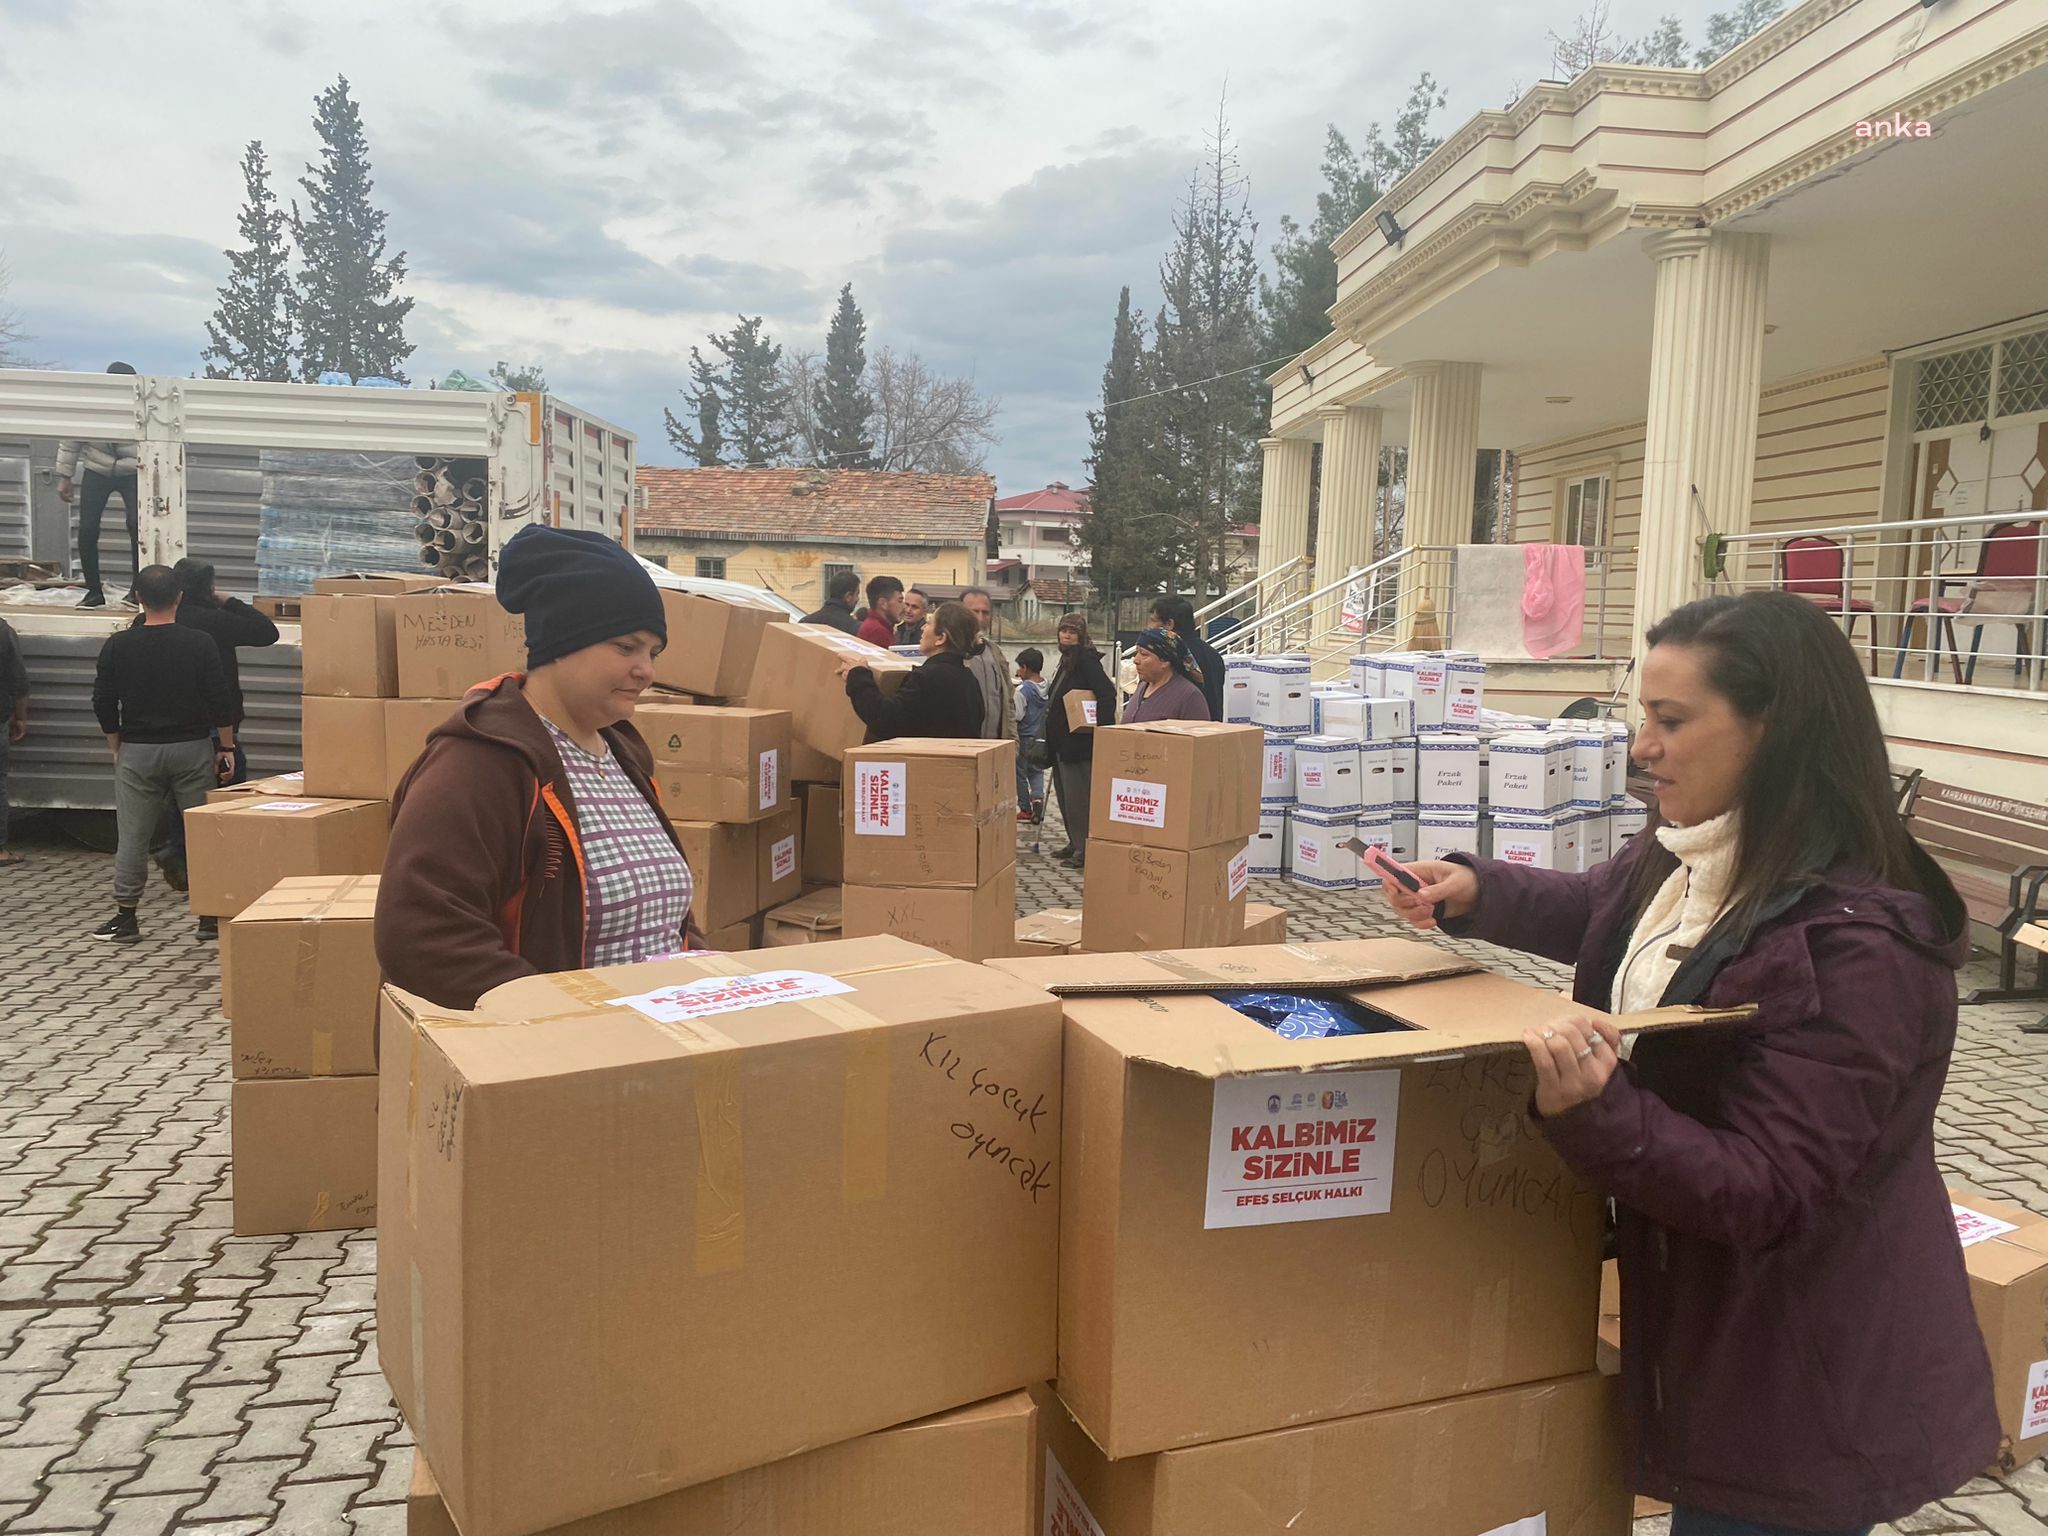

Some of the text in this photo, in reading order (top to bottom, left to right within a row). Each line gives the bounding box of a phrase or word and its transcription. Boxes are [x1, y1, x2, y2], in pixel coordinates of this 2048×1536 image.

[1437, 770, 1462, 778] Erzak
[1504, 772, 1528, 781] Erzak
[1436, 779, 1463, 787] Paketi
[1503, 781, 1529, 790] Paketi
[1116, 793, 1160, 808] KALBiMiZ
[1119, 803, 1155, 816] SiZiNLE
[676, 981, 802, 1008] SiZiNLE
[1426, 1054, 1532, 1097] ERKE
[1230, 1118, 1377, 1151] KALBiMiZ
[1242, 1148, 1361, 1181] SiZiNLE
[1236, 1186, 1363, 1207] EFES SELÇUK HALKI
